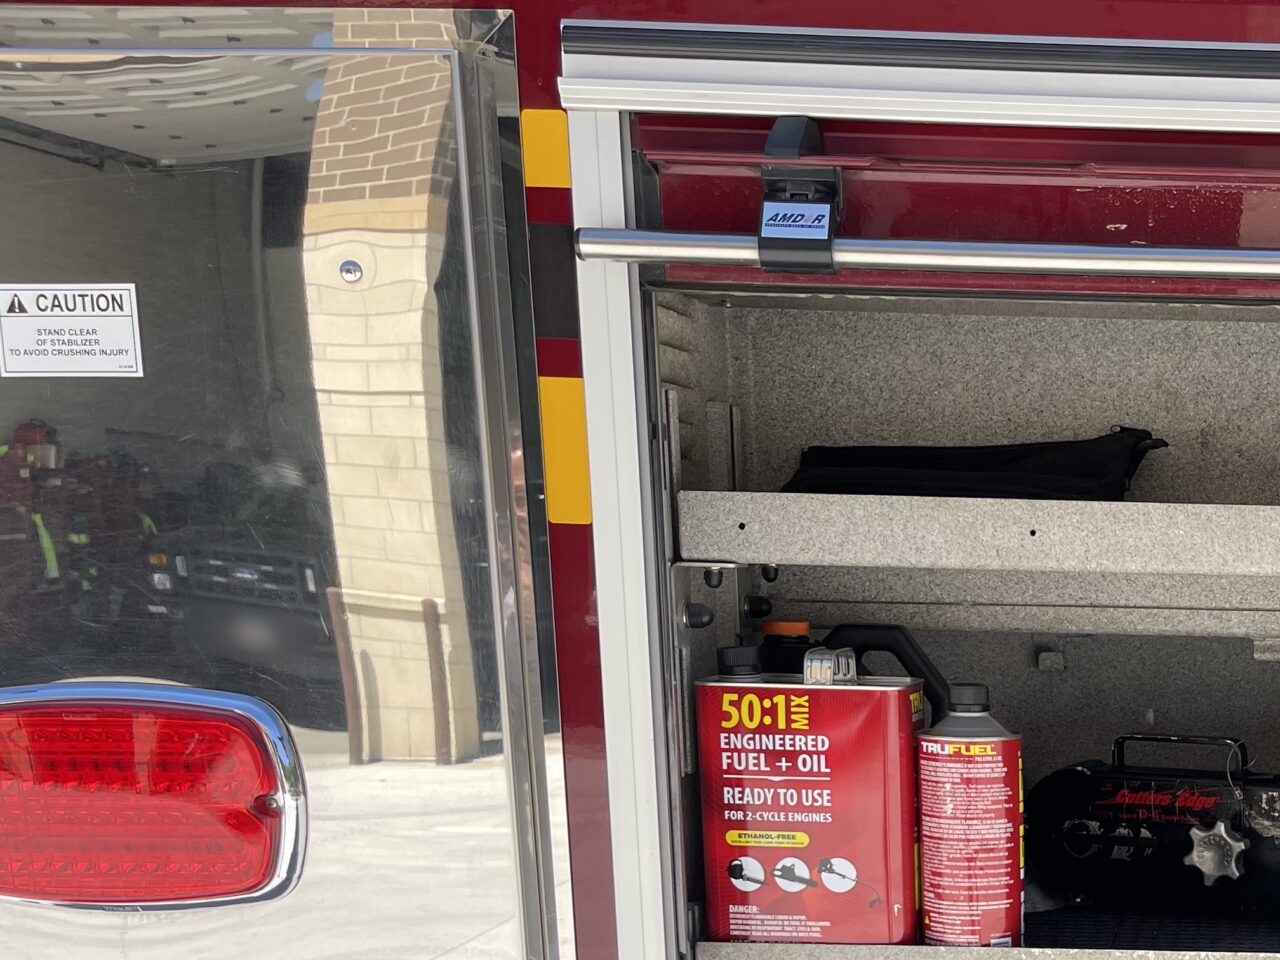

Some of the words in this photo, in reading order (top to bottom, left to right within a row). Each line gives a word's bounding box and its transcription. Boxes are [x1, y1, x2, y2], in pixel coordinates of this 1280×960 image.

[35, 293, 125, 312] CAUTION
[721, 693, 786, 730] 50:1
[790, 694, 810, 730] MIX
[720, 733, 830, 752] ENGINEERED
[921, 741, 997, 756] TRUFUEL
[721, 752, 771, 771] FUEL
[776, 757, 792, 771] +
[797, 754, 831, 773] OIL
[723, 787, 774, 805] READY
[777, 788, 798, 806] TO
[802, 789, 832, 807] USE
[724, 810, 744, 820] FOR
[746, 811, 786, 821] 2-CYCLE
[788, 812, 833, 823] ENGINES
[729, 904, 760, 914] DANGER:
